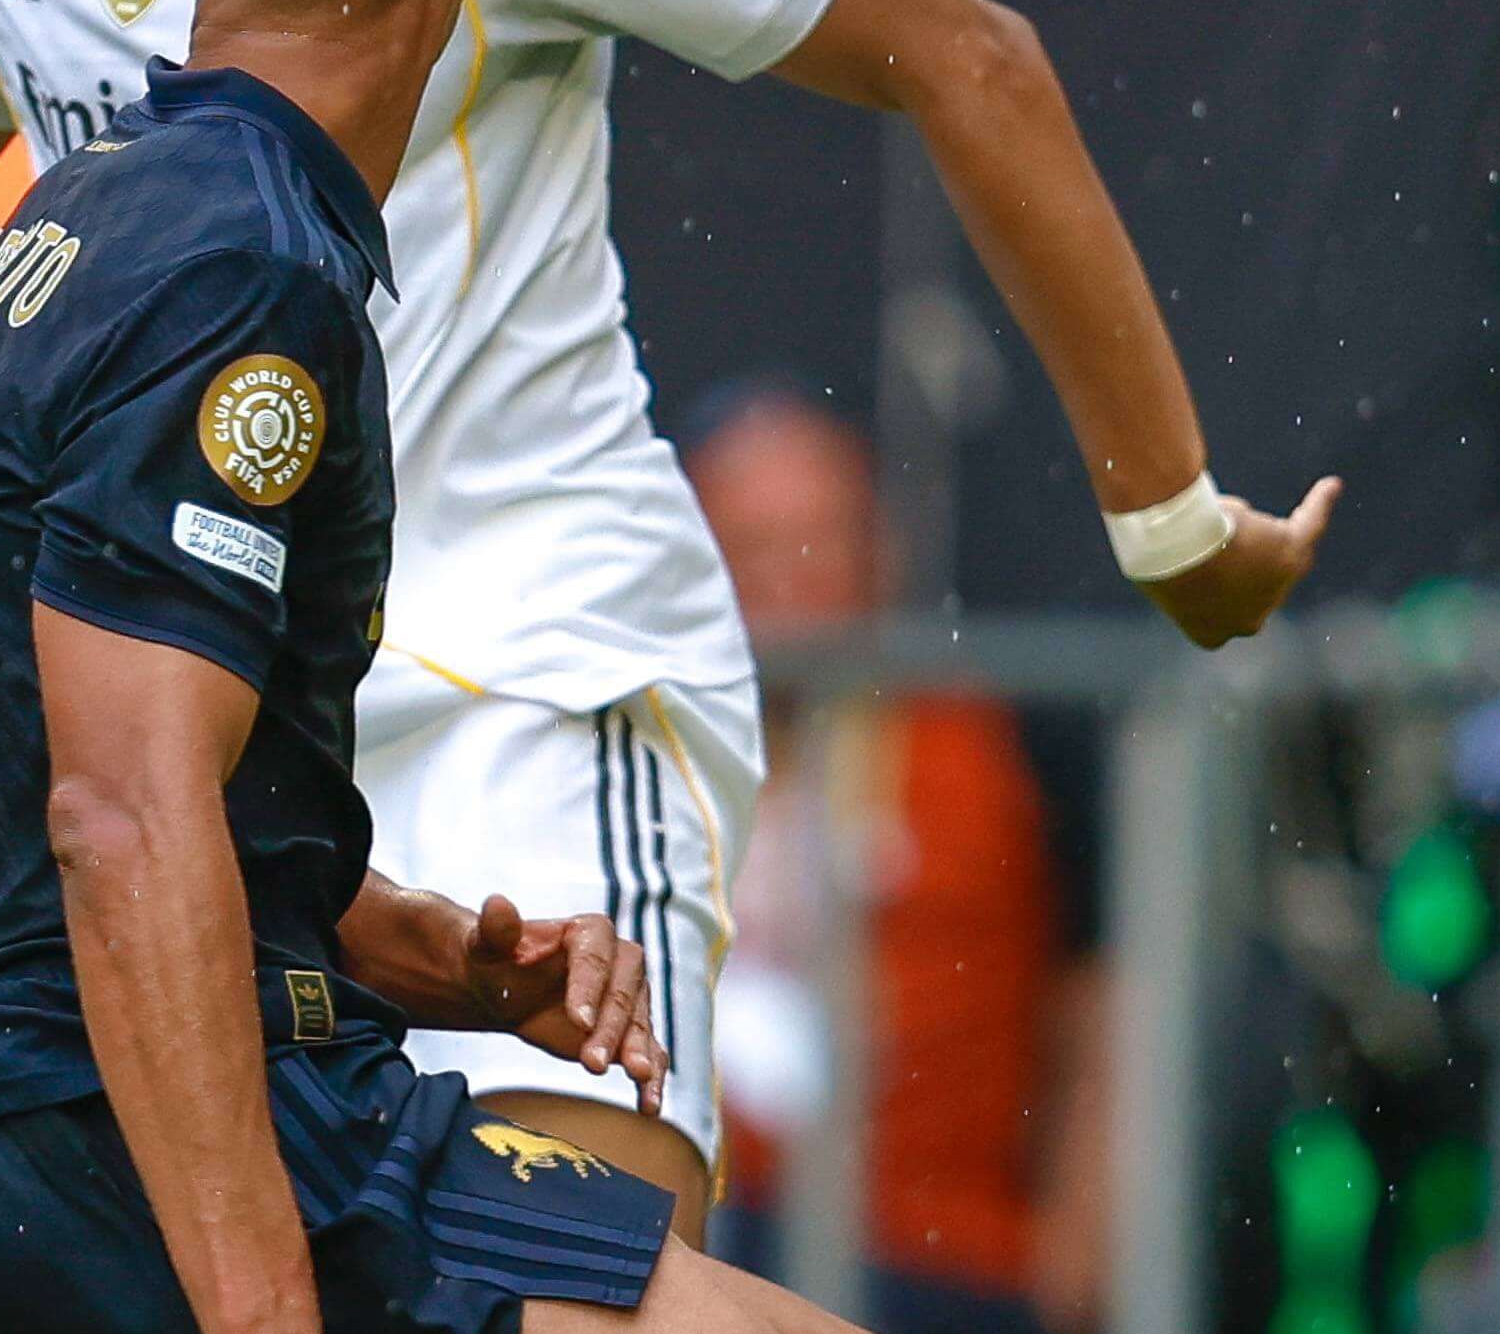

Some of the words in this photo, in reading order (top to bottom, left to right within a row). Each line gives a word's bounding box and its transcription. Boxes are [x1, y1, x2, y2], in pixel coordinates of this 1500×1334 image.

[229, 370, 292, 393] WORLD
[214, 394, 234, 442] CLUB
[292, 389, 314, 424] CUP
[297, 431, 313, 454] 25
[224, 452, 265, 494] FIFA
[272, 457, 301, 485] USA
